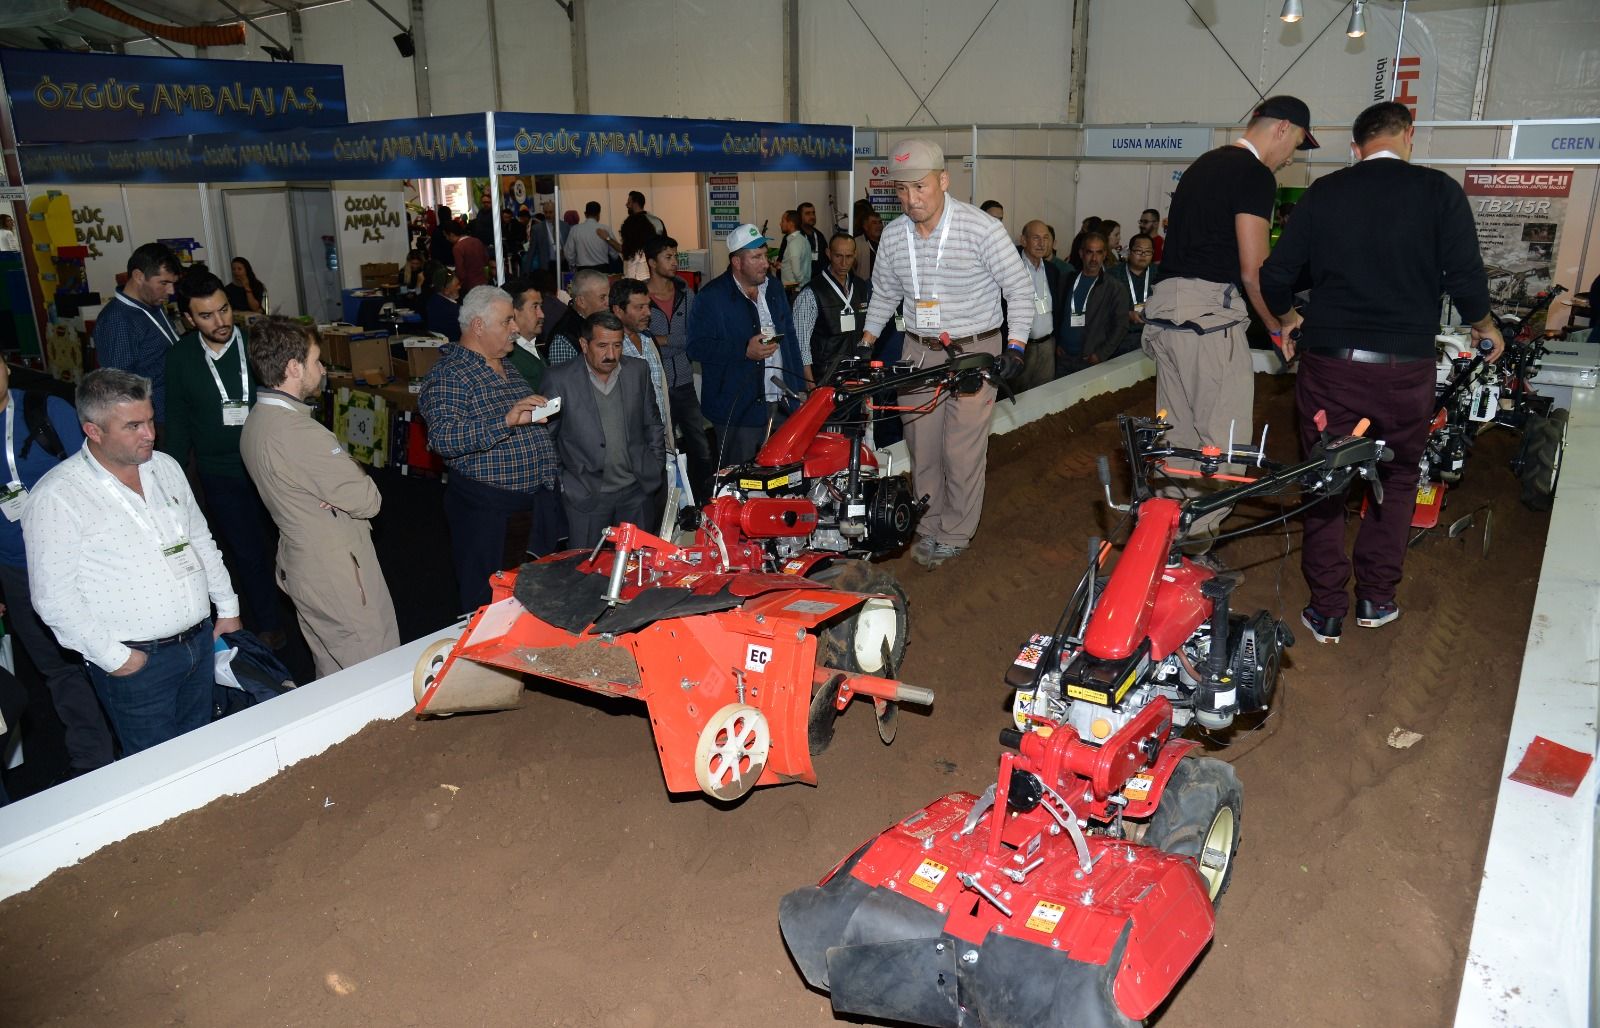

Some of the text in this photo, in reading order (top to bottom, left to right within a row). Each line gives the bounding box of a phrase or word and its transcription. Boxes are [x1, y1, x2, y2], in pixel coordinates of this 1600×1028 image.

[34, 75, 144, 118] ÖZGÜÇ
[151, 82, 275, 116] AMBALAJ
[333, 135, 379, 163] ÖZGÜÇ
[381, 132, 447, 162] AMBALAJ
[513, 127, 582, 158] ÖZGÜÇ
[586, 129, 662, 158] AMBALAJ
[1112, 136, 1183, 149] LUSNA MAKİNE
[1551, 137, 1595, 150] CEREN
[497, 164, 518, 172] 4-C136
[344, 194, 388, 212] ÖZGÜÇ
[1476, 199, 1552, 215] TB215R
[72, 205, 105, 225] GÜÇ
[344, 211, 401, 231] AMBALAJ
[75, 224, 124, 244] BALAJ
[750, 649, 767, 664] EC
